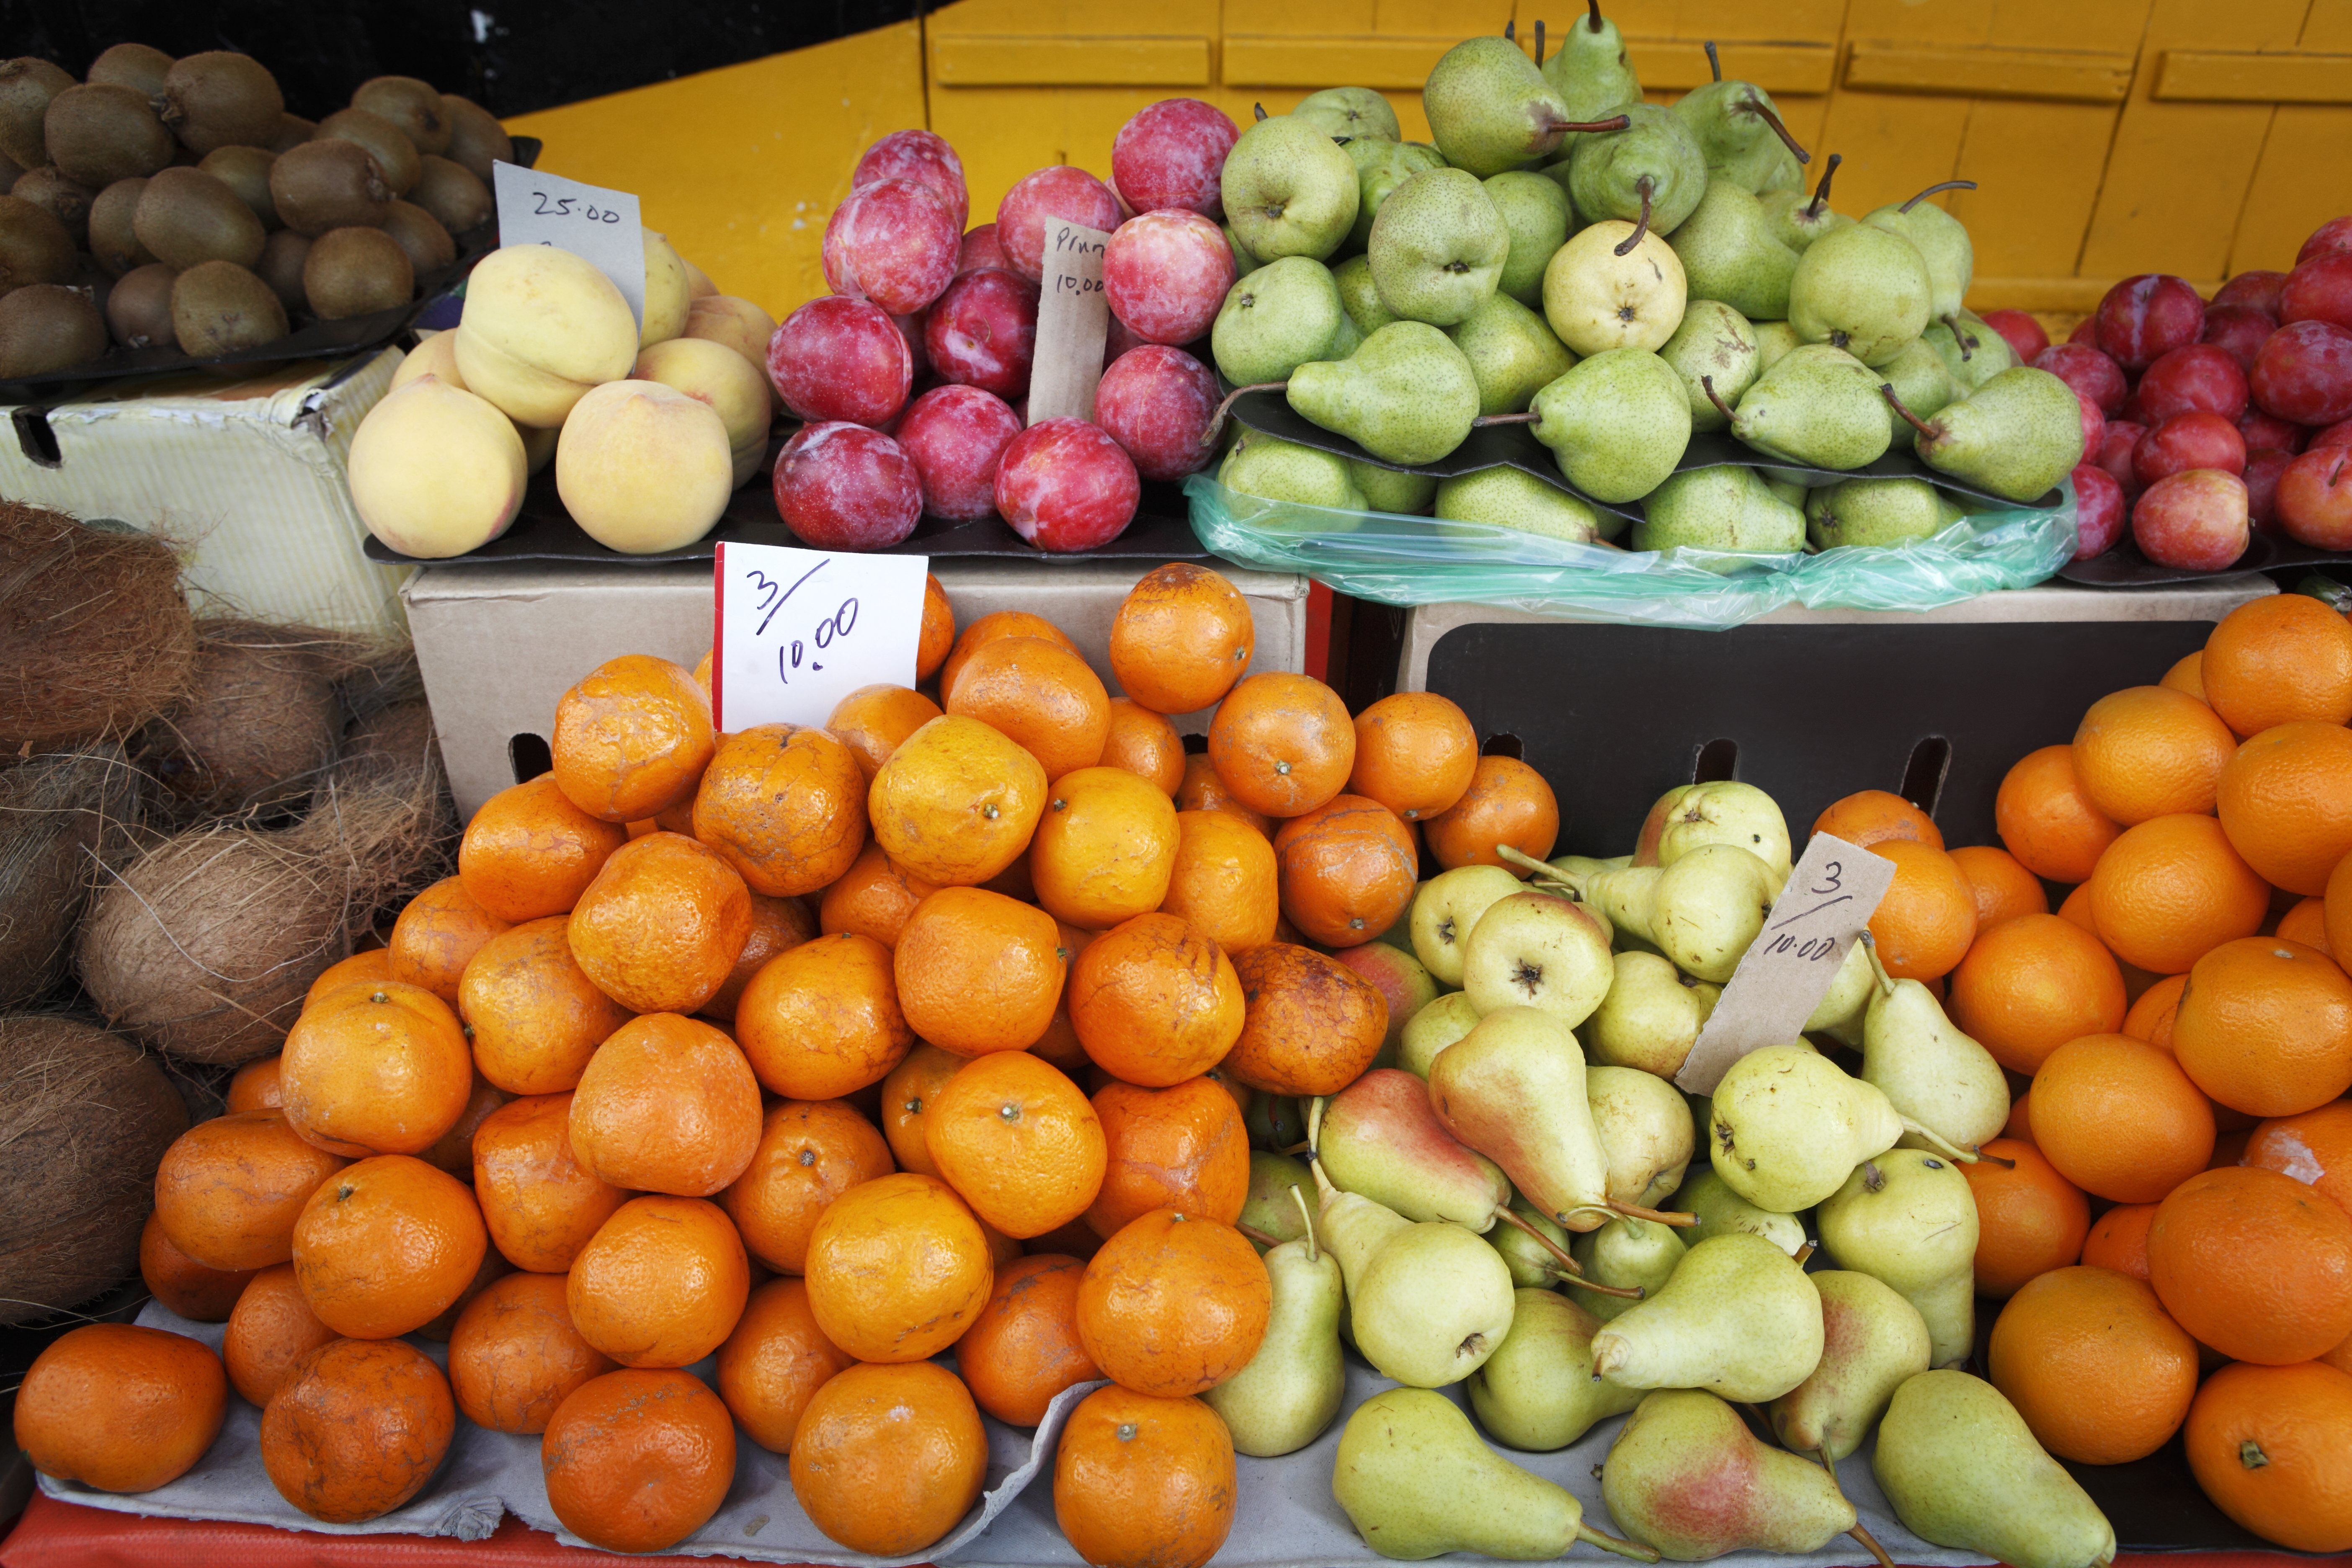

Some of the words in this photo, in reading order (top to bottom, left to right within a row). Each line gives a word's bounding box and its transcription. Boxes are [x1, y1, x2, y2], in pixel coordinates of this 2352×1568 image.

[533, 192, 619, 223] 25.00
[1057, 274, 1104, 296] 10.00
[779, 598, 859, 684] 10.00
[1764, 934, 1835, 961] 10.00
